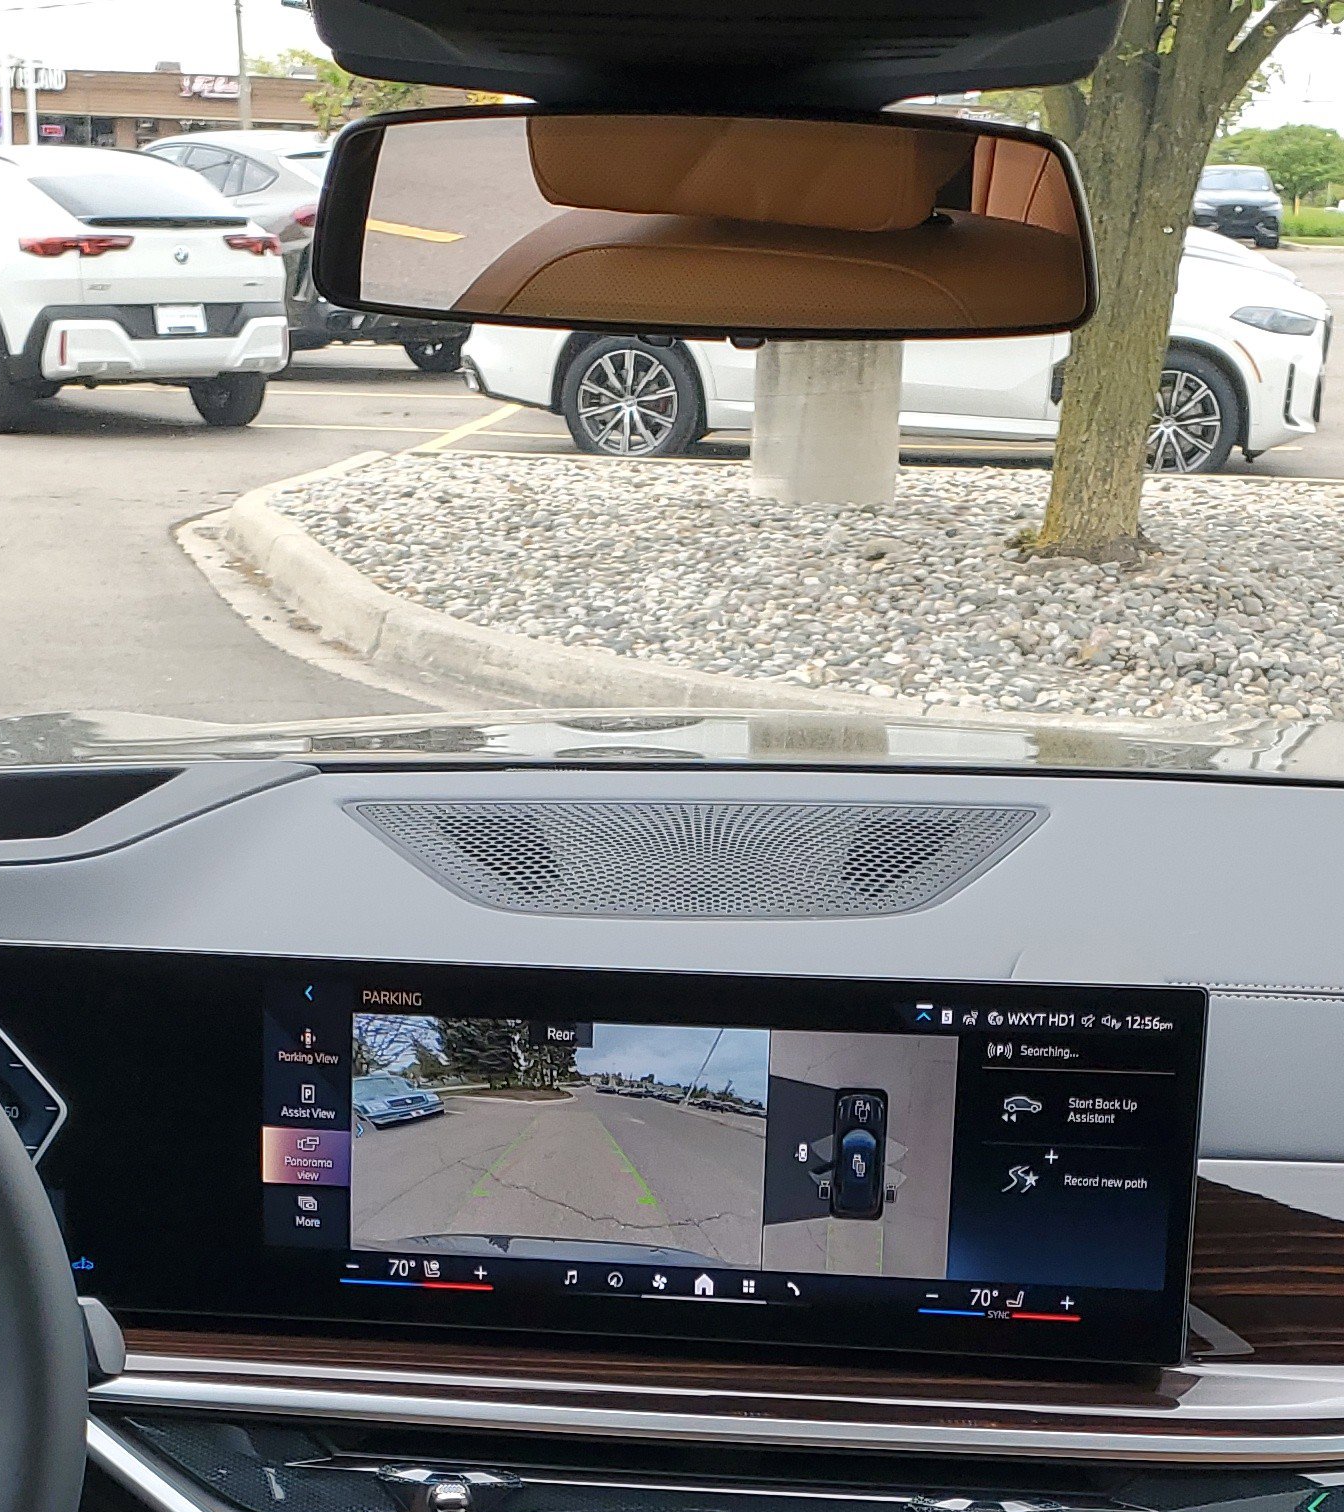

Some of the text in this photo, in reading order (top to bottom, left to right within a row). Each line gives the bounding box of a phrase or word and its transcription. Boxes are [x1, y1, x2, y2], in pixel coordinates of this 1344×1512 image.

[363, 990, 422, 1006] PARKING
[1008, 1013, 1075, 1027] WXYT HD1
[547, 1027, 574, 1041] Rear
[278, 1051, 339, 1065] Parking View
[1068, 1098, 1138, 1112] Start Back Up
[281, 1106, 335, 1120] Assist View
[1067, 1112, 1115, 1124] Assistant
[285, 1156, 333, 1168] Panorama
[297, 1171, 319, 1181] view
[1064, 1175, 1148, 1190] Record new path
[295, 1216, 321, 1228] More
[987, 1310, 1009, 1319] SYNC
